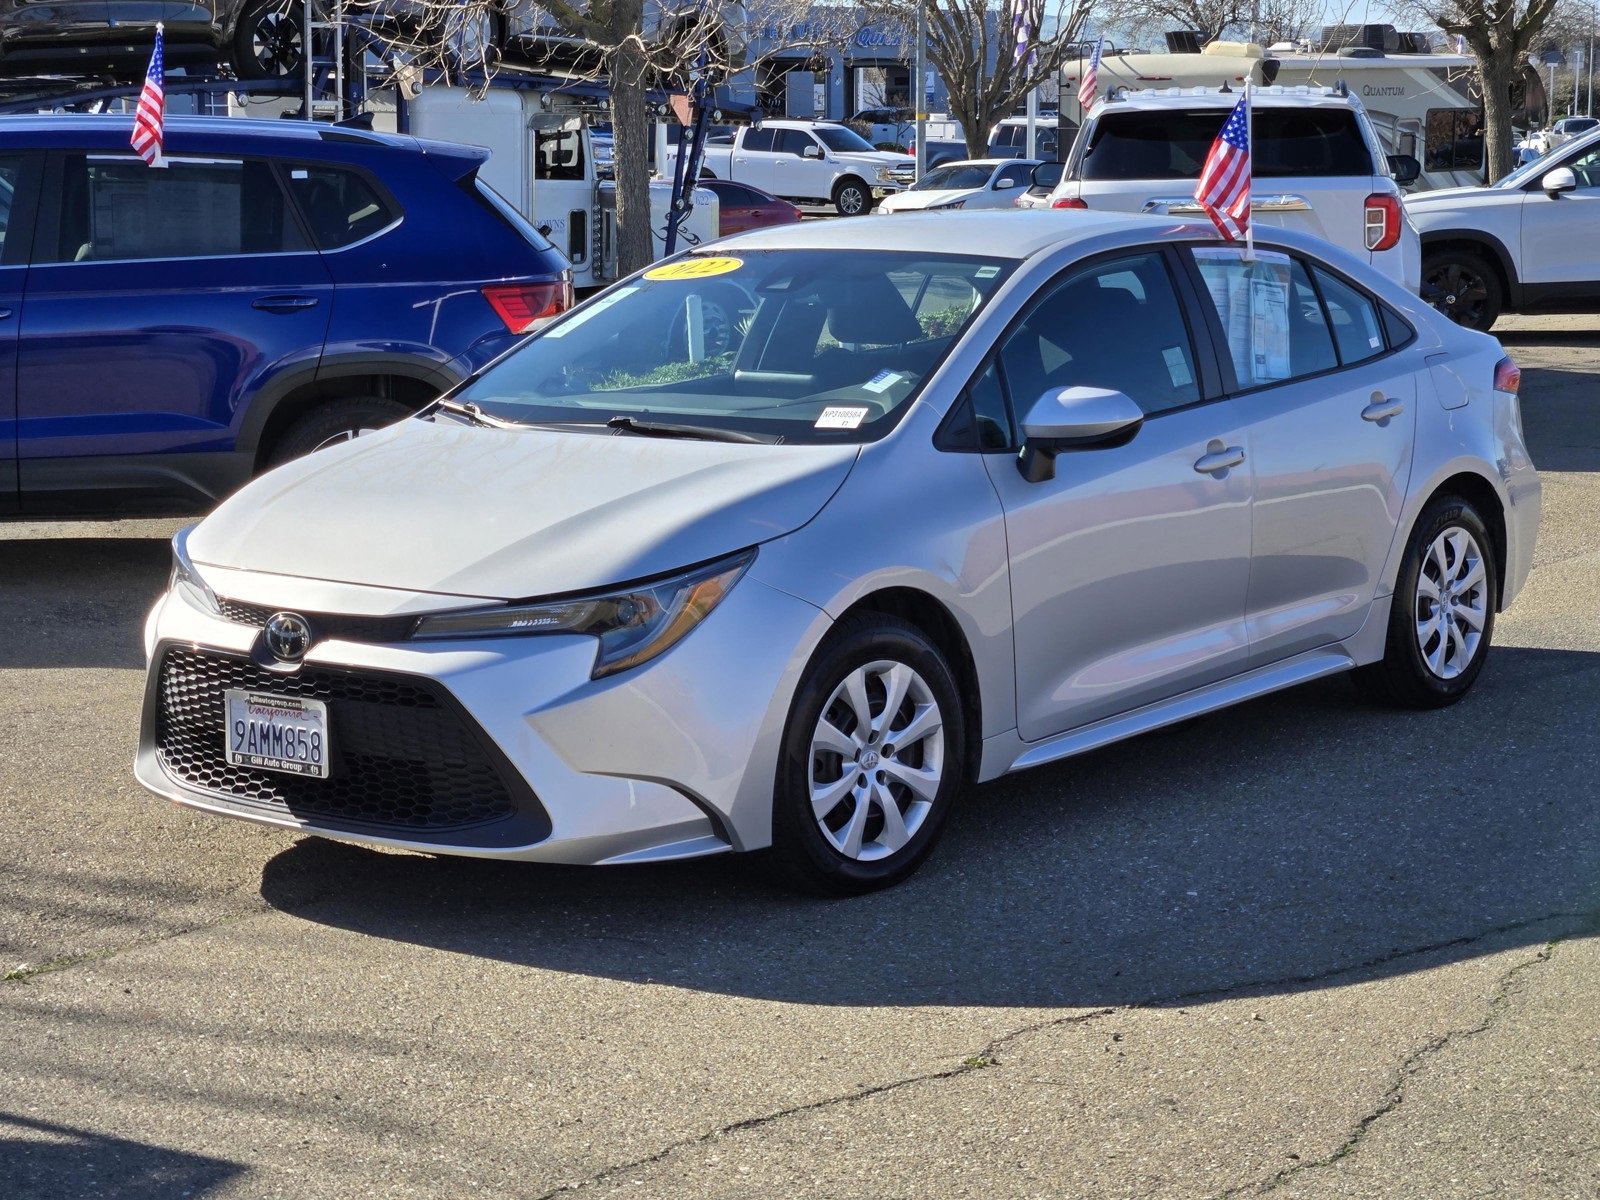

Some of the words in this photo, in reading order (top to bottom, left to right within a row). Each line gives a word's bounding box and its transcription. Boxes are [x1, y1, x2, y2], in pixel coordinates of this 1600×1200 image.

[654, 260, 732, 277] 2022
[235, 719, 322, 764] 9AMM858
[250, 755, 263, 765] Gill
[263, 758, 280, 768] Auto
[281, 761, 303, 773] Group
